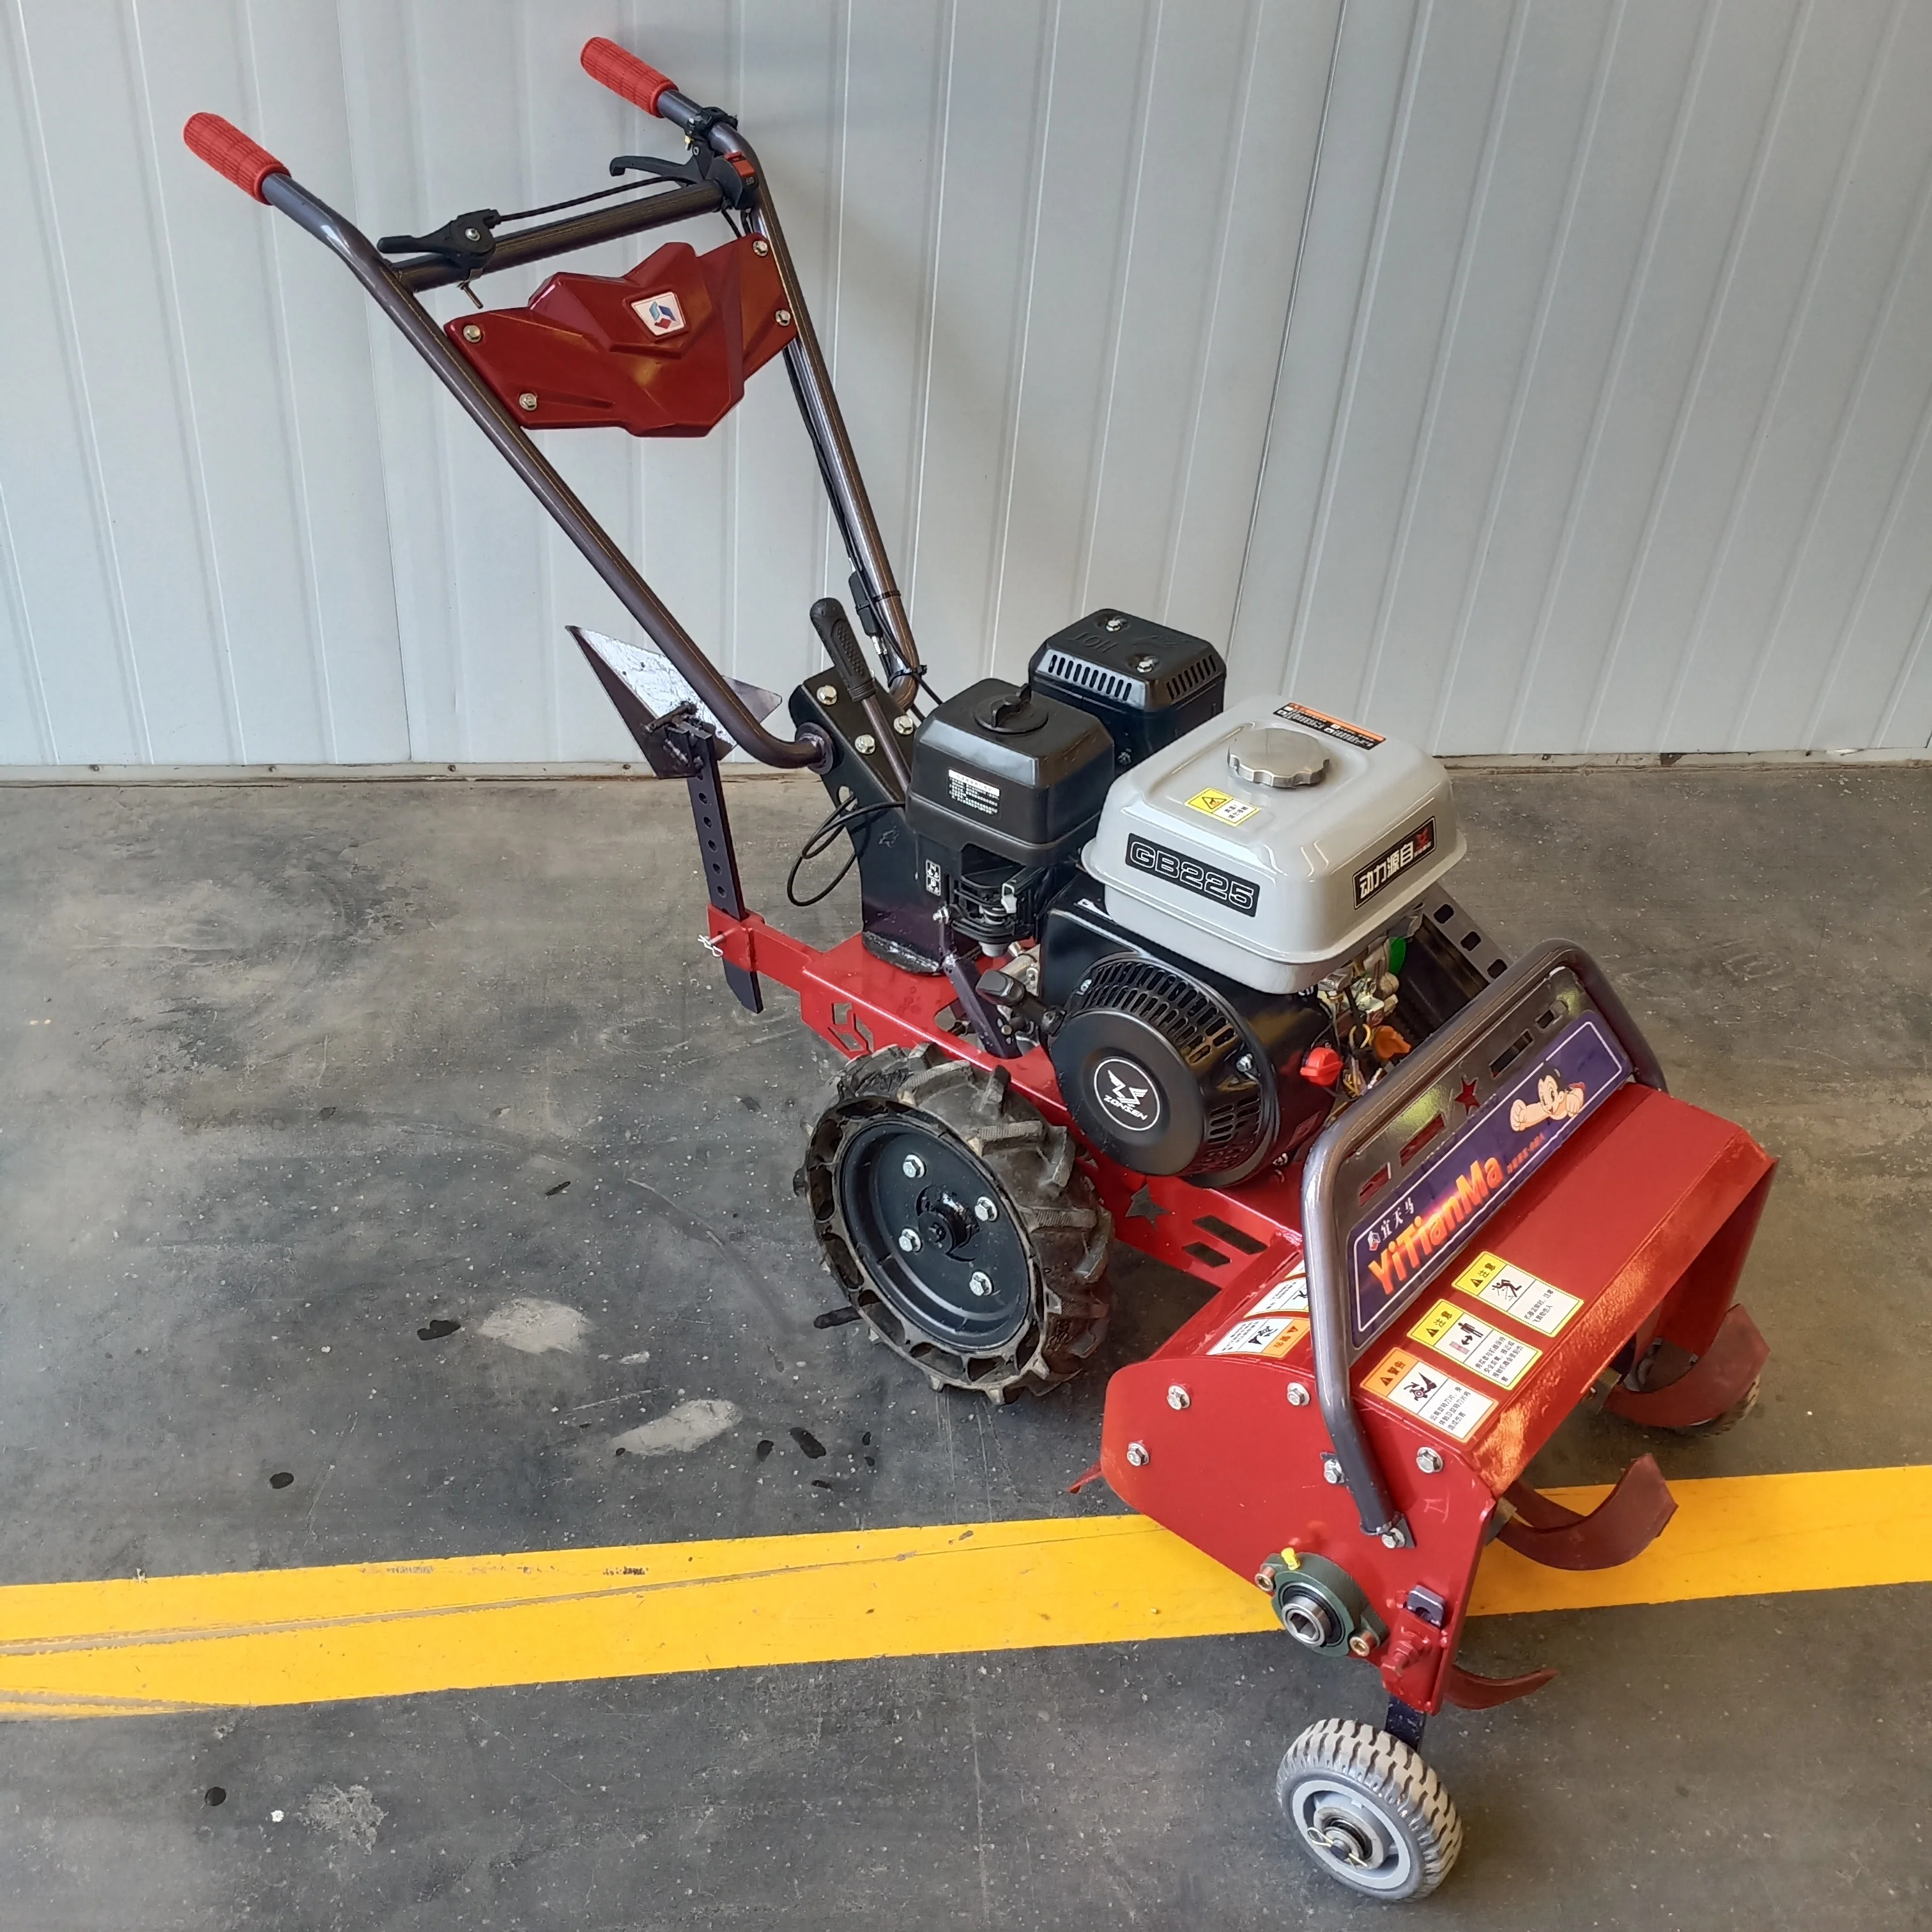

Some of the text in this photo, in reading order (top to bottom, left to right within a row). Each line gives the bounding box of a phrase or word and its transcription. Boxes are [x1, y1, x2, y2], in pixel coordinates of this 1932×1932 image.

[1130, 841, 1255, 910] GB225
[1359, 841, 1414, 900] 动力源自
[1368, 1156, 1504, 1296] YiTianMa
[1477, 1262, 1496, 1278] 注意
[1433, 1310, 1453, 1328] 注意
[1386, 1360, 1406, 1376] 警告
